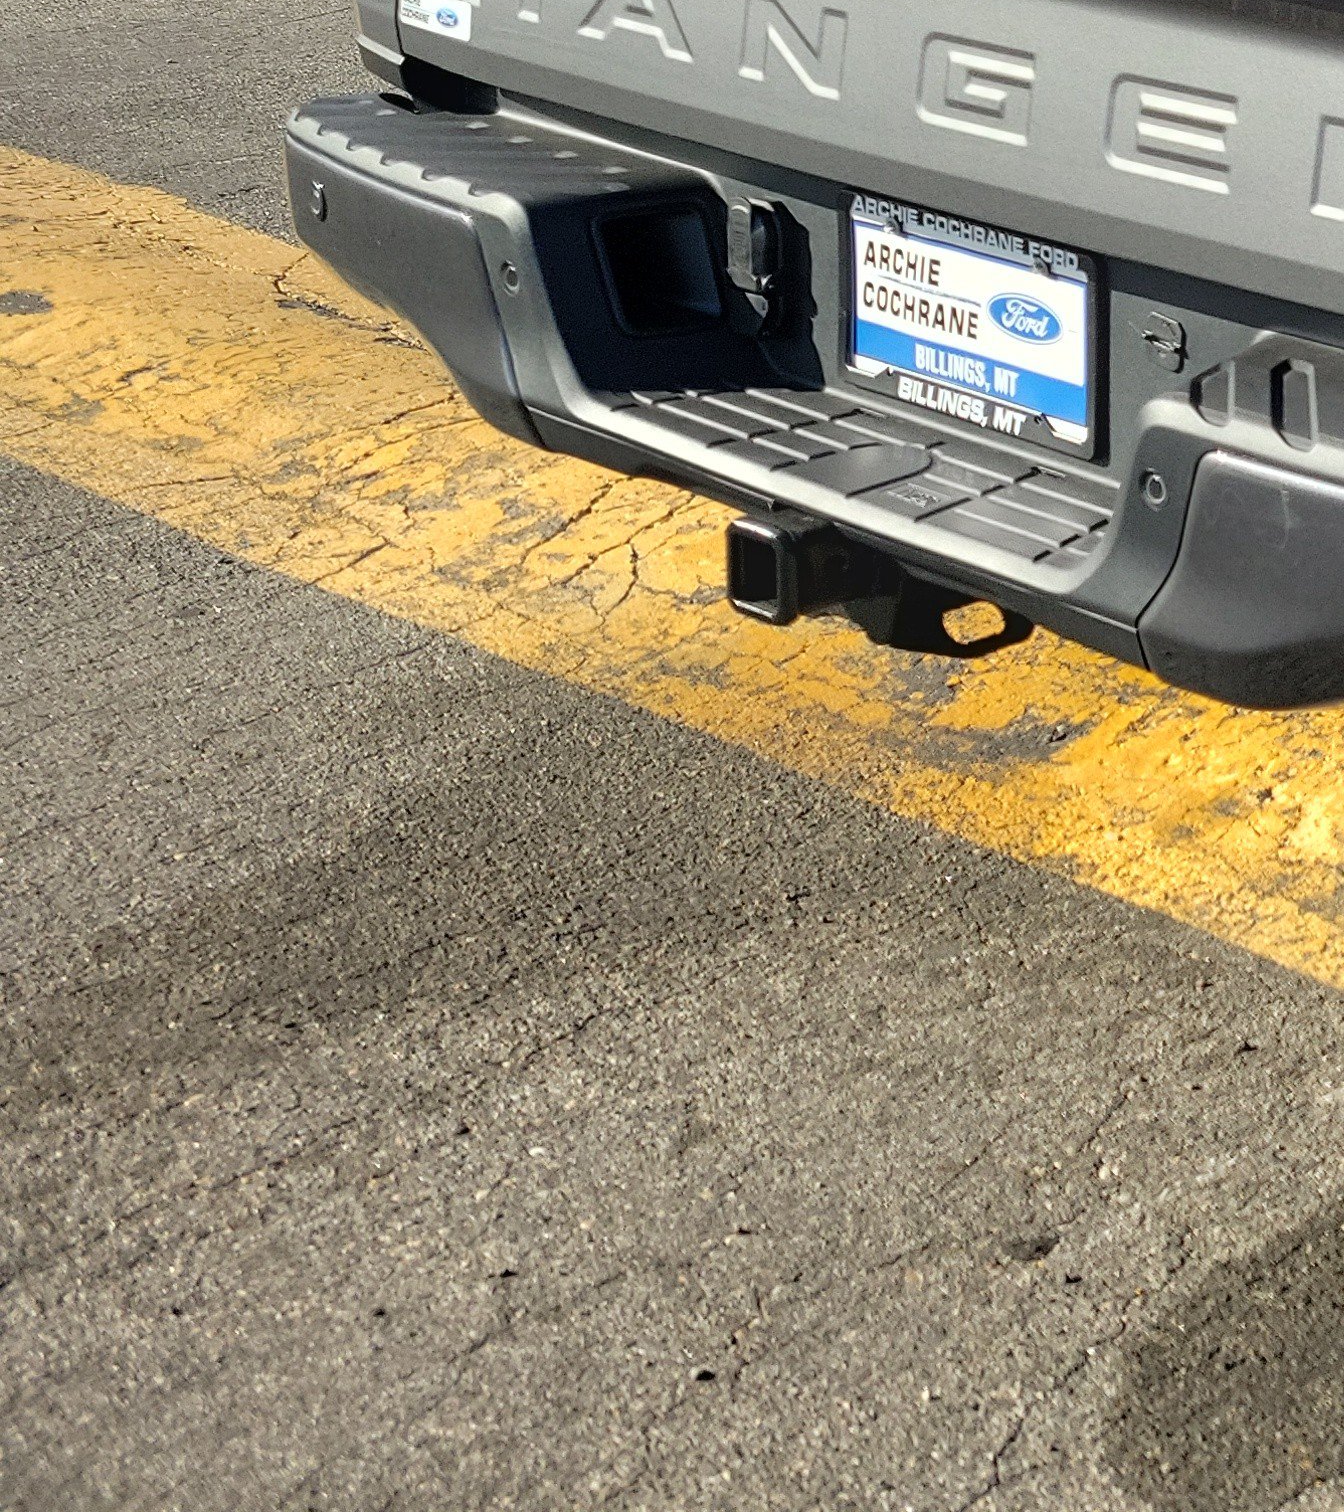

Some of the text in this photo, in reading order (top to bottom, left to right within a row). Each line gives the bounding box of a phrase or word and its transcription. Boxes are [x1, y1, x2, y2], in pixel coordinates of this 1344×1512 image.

[853, 194, 1080, 272] ARCHIE COCHRANE FORD
[863, 240, 942, 287] ARCHIE
[863, 281, 979, 340] COCHRANE
[1001, 298, 1050, 338] Ford
[914, 342, 1020, 398] BILLINGS, MT
[897, 375, 1027, 436] BILLINGS, MT
